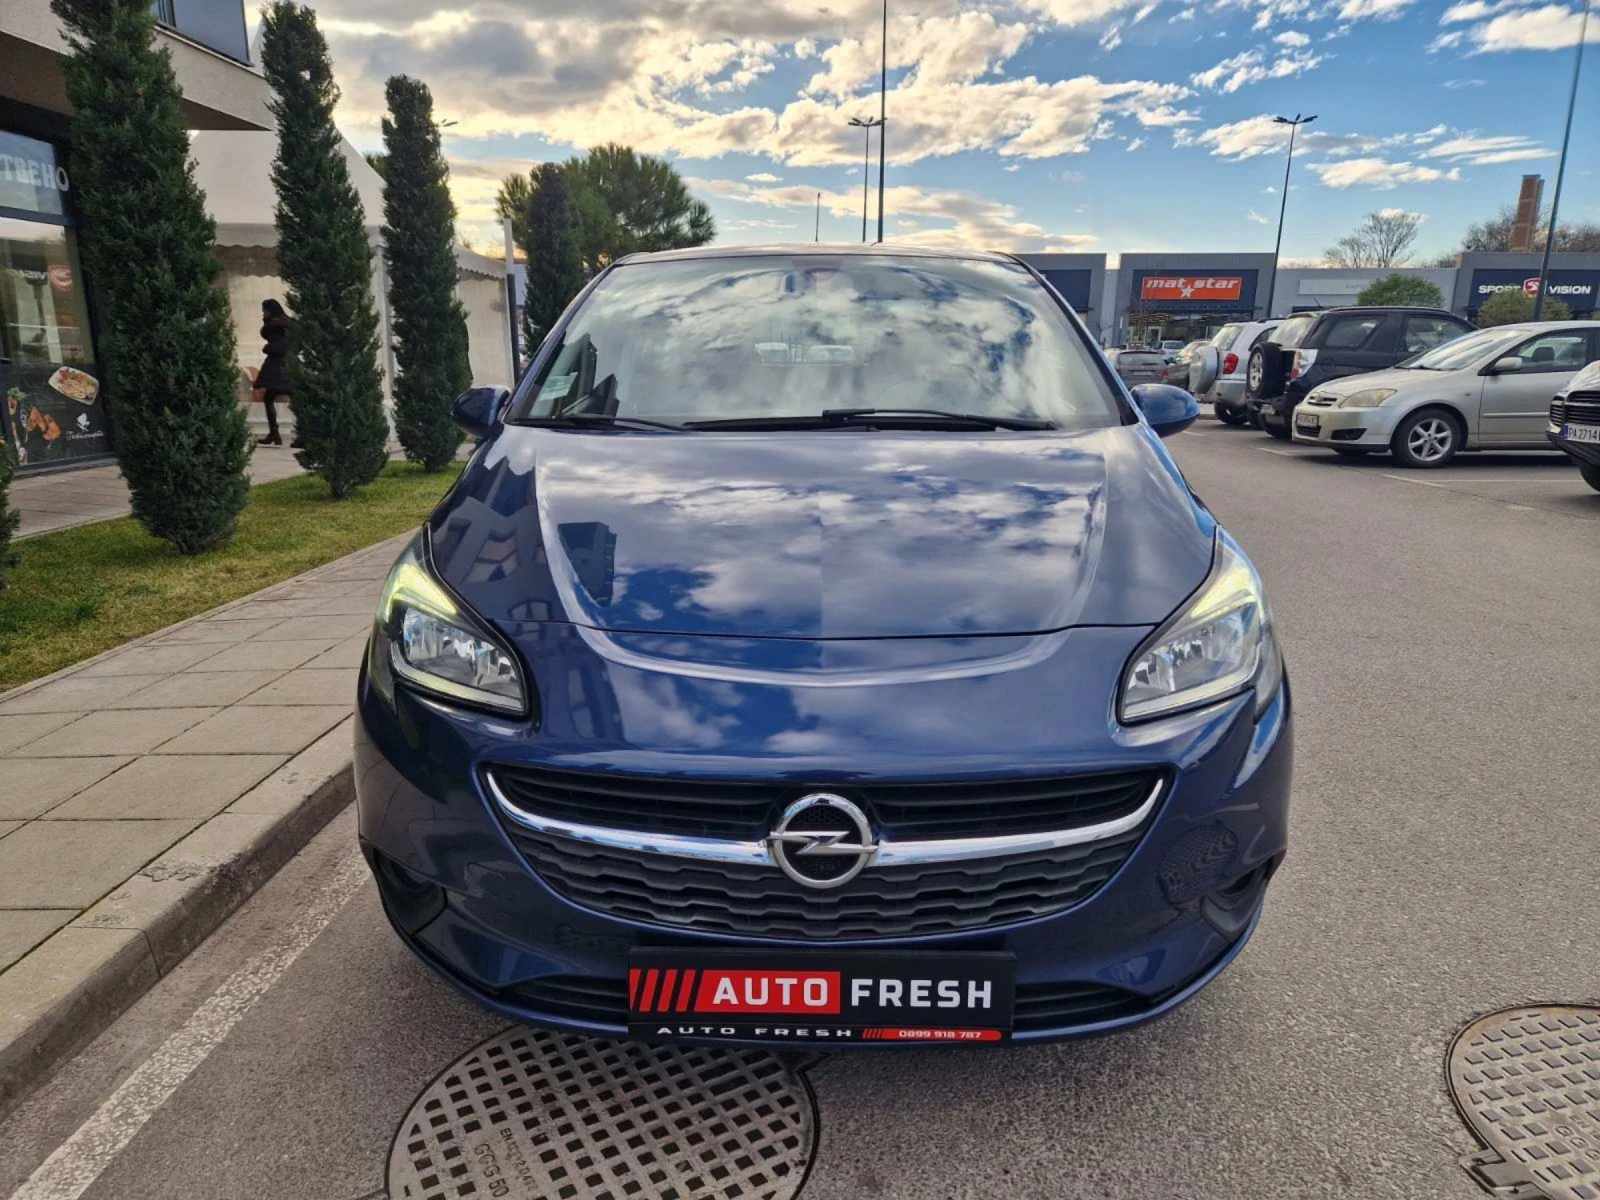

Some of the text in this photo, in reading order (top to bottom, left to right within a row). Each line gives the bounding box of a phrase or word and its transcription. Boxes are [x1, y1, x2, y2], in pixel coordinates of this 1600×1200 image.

[1146, 278, 1239, 288] mat star
[1549, 285, 1591, 294] VISION
[713, 977, 992, 1009] AUTO FRESH
[657, 1027, 736, 1035] AUTO
[755, 1028, 851, 1037] FRESH
[488, 1178, 509, 1198] 50
